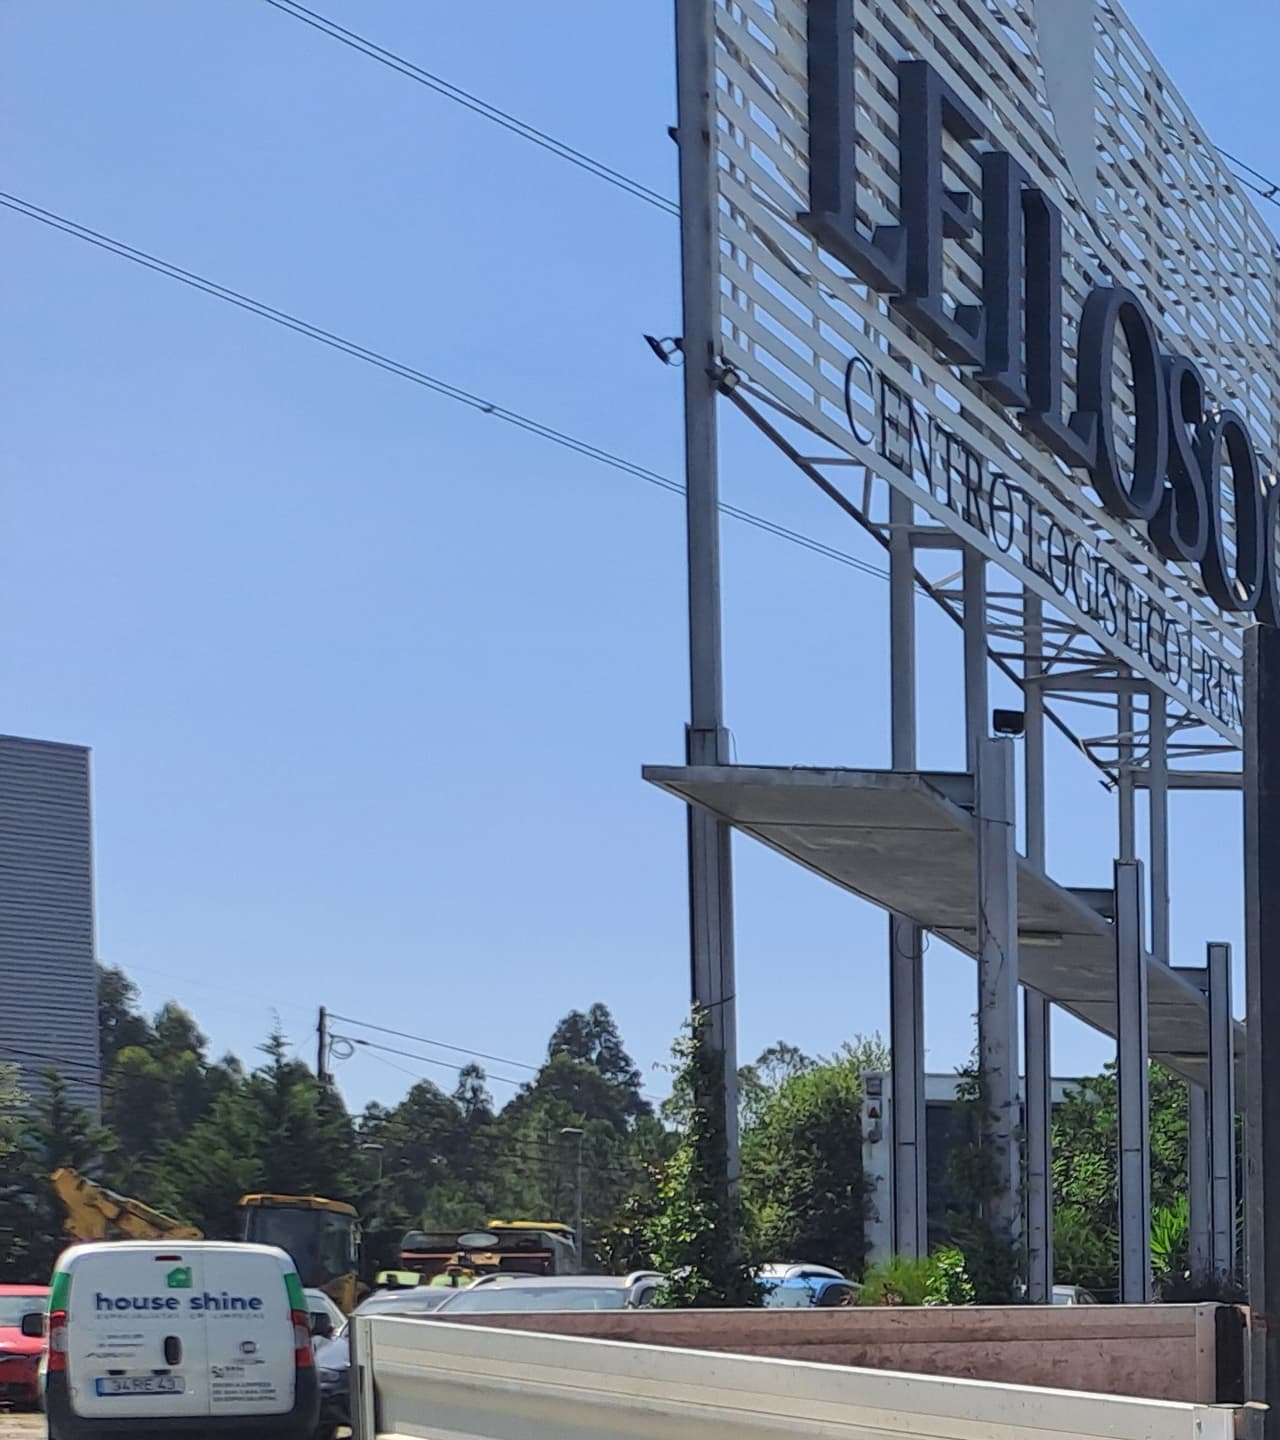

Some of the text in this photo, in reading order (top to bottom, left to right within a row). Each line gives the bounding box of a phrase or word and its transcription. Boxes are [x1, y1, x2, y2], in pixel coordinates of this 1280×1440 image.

[845, 356, 1014, 553] CENTRO
[96, 1292, 264, 1310] house shine
